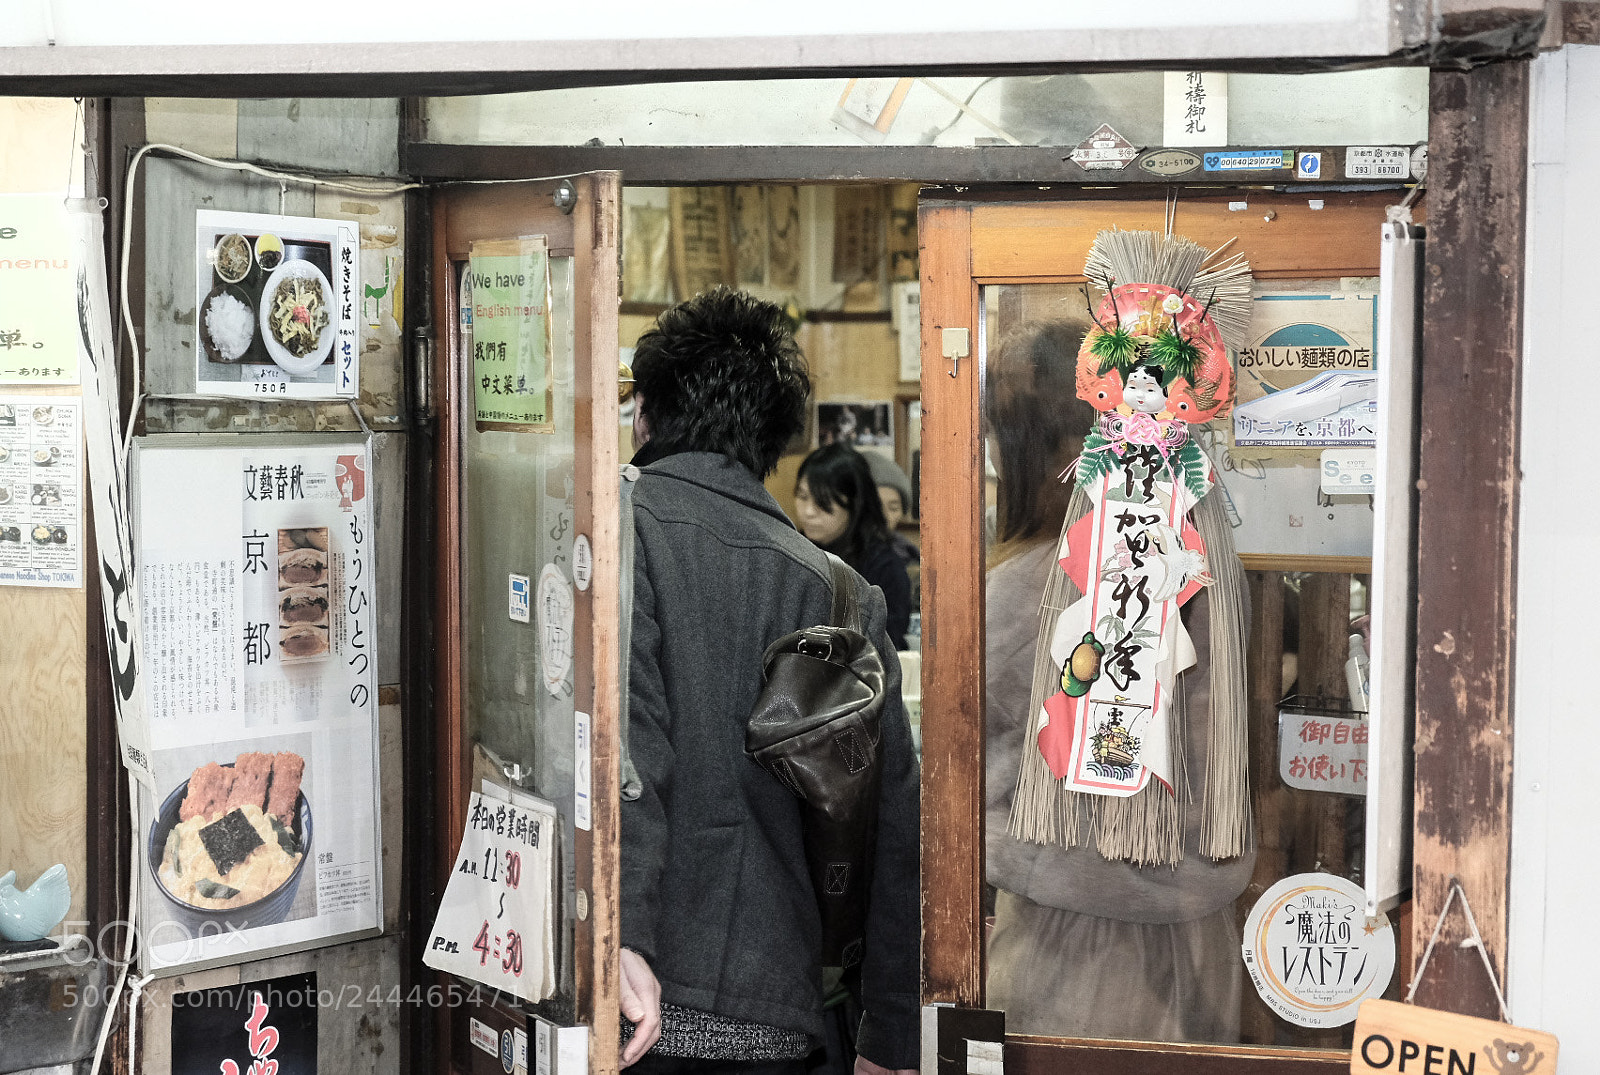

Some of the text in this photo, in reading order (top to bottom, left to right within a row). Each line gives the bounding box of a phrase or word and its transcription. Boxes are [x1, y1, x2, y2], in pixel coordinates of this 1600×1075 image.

[1158, 158, 1194, 168] 34-5100
[1355, 166, 1368, 174] 393
[472, 271, 526, 289] We have
[476, 304, 543, 319] English menu
[341, 341, 352, 388] セット
[475, 341, 507, 362] 我們有
[0, 367, 65, 377] ーあります
[254, 382, 287, 394] 750円
[243, 464, 305, 501] 文藝春秋
[242, 529, 272, 666] 京都
[348, 514, 369, 708] もうひとつの
[1299, 720, 1368, 745] 御自由
[1289, 754, 1368, 783] お使い下
[471, 797, 541, 850] 本日の営業時間
[483, 847, 521, 890] 11:30
[1301, 895, 1339, 910] Maki's
[1297, 911, 1351, 945] 魔法の
[472, 919, 524, 978] 4:30
[1282, 946, 1368, 986] レストラン
[1361, 1034, 1476, 1075] OPEN
